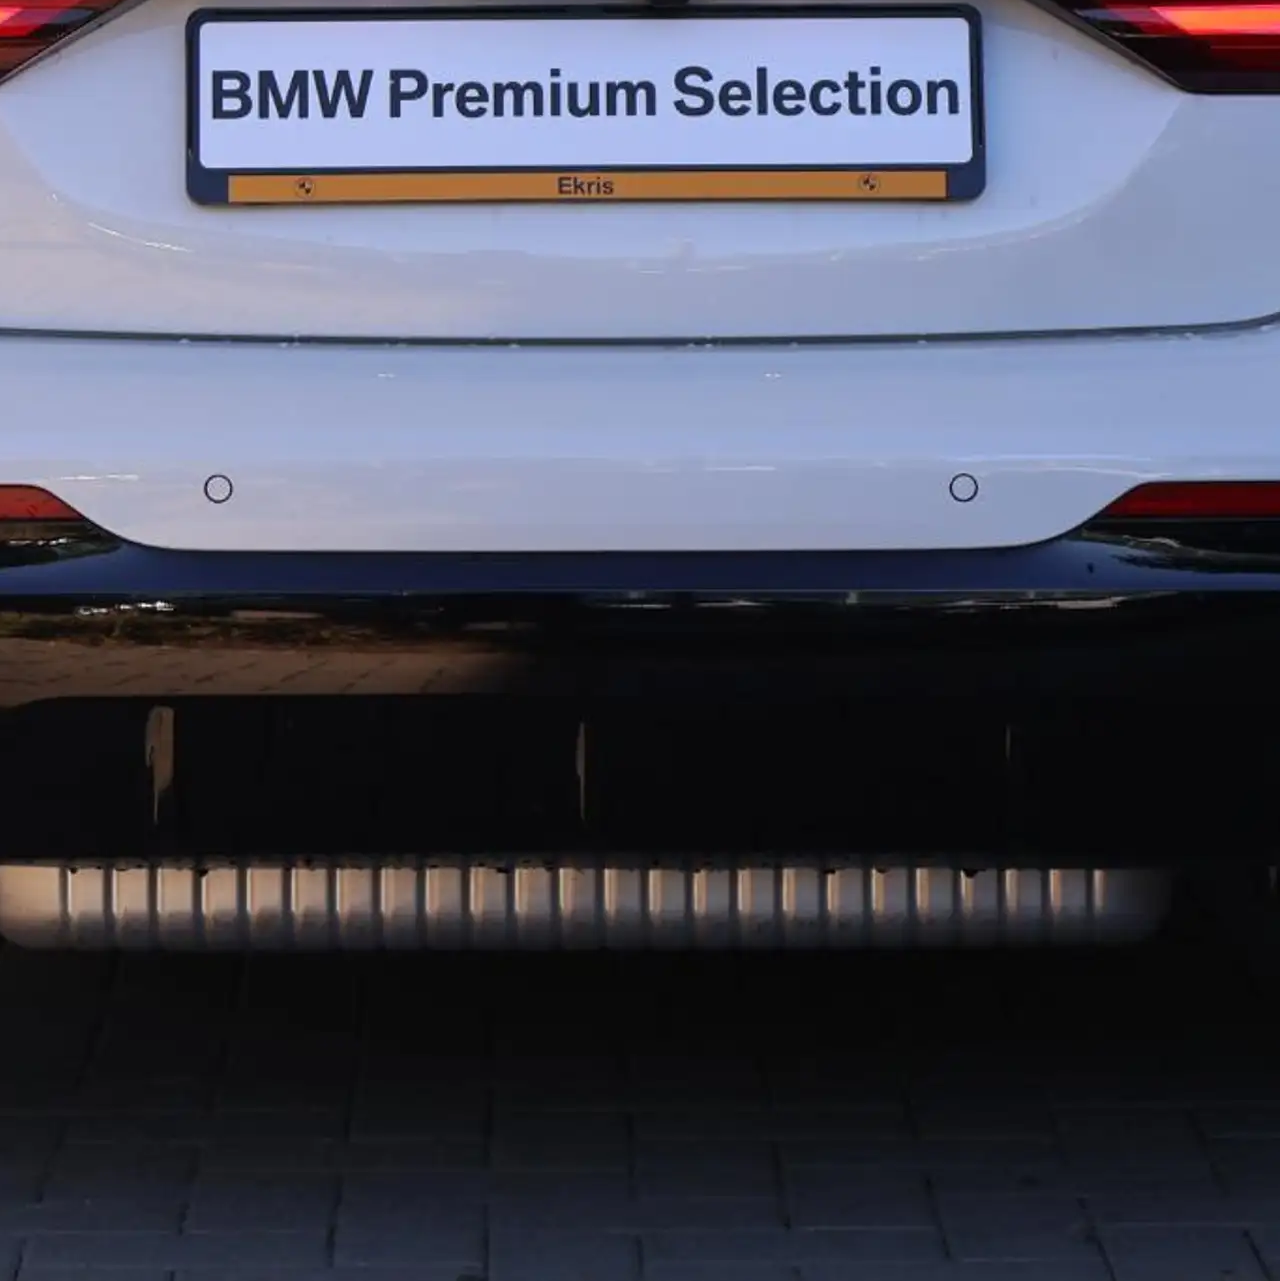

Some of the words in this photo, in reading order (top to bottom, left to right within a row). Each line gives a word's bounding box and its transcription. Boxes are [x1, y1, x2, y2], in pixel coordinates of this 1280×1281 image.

[211, 69, 373, 120] BMW
[388, 68, 657, 118] Premium
[673, 66, 960, 117] Selection
[558, 176, 614, 195] Ekris
